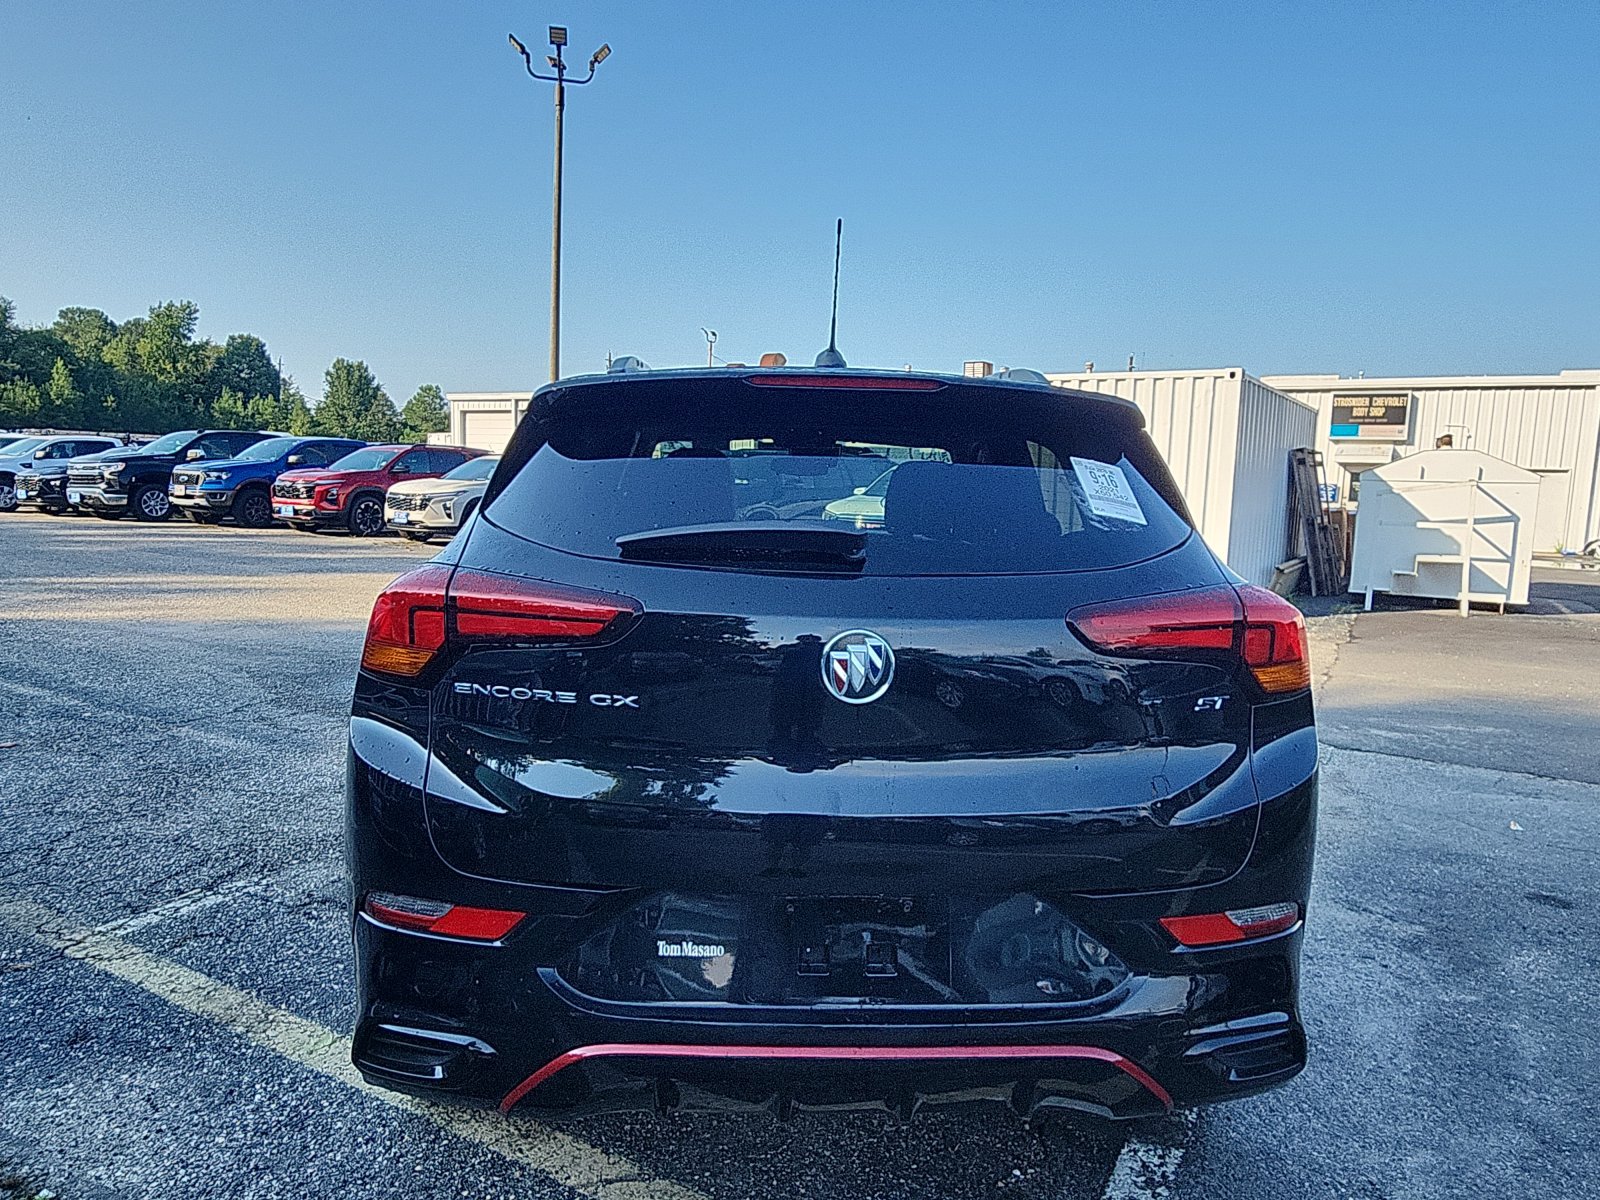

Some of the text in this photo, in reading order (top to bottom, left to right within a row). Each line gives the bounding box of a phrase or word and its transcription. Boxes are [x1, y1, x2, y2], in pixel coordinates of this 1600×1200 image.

[1371, 397, 1408, 407] CHEVROLET
[1352, 407, 1386, 417] BODY SHOP
[1089, 470, 1118, 488] 9:16
[454, 682, 639, 708] ENCORE GX
[1194, 695, 1230, 712] ST
